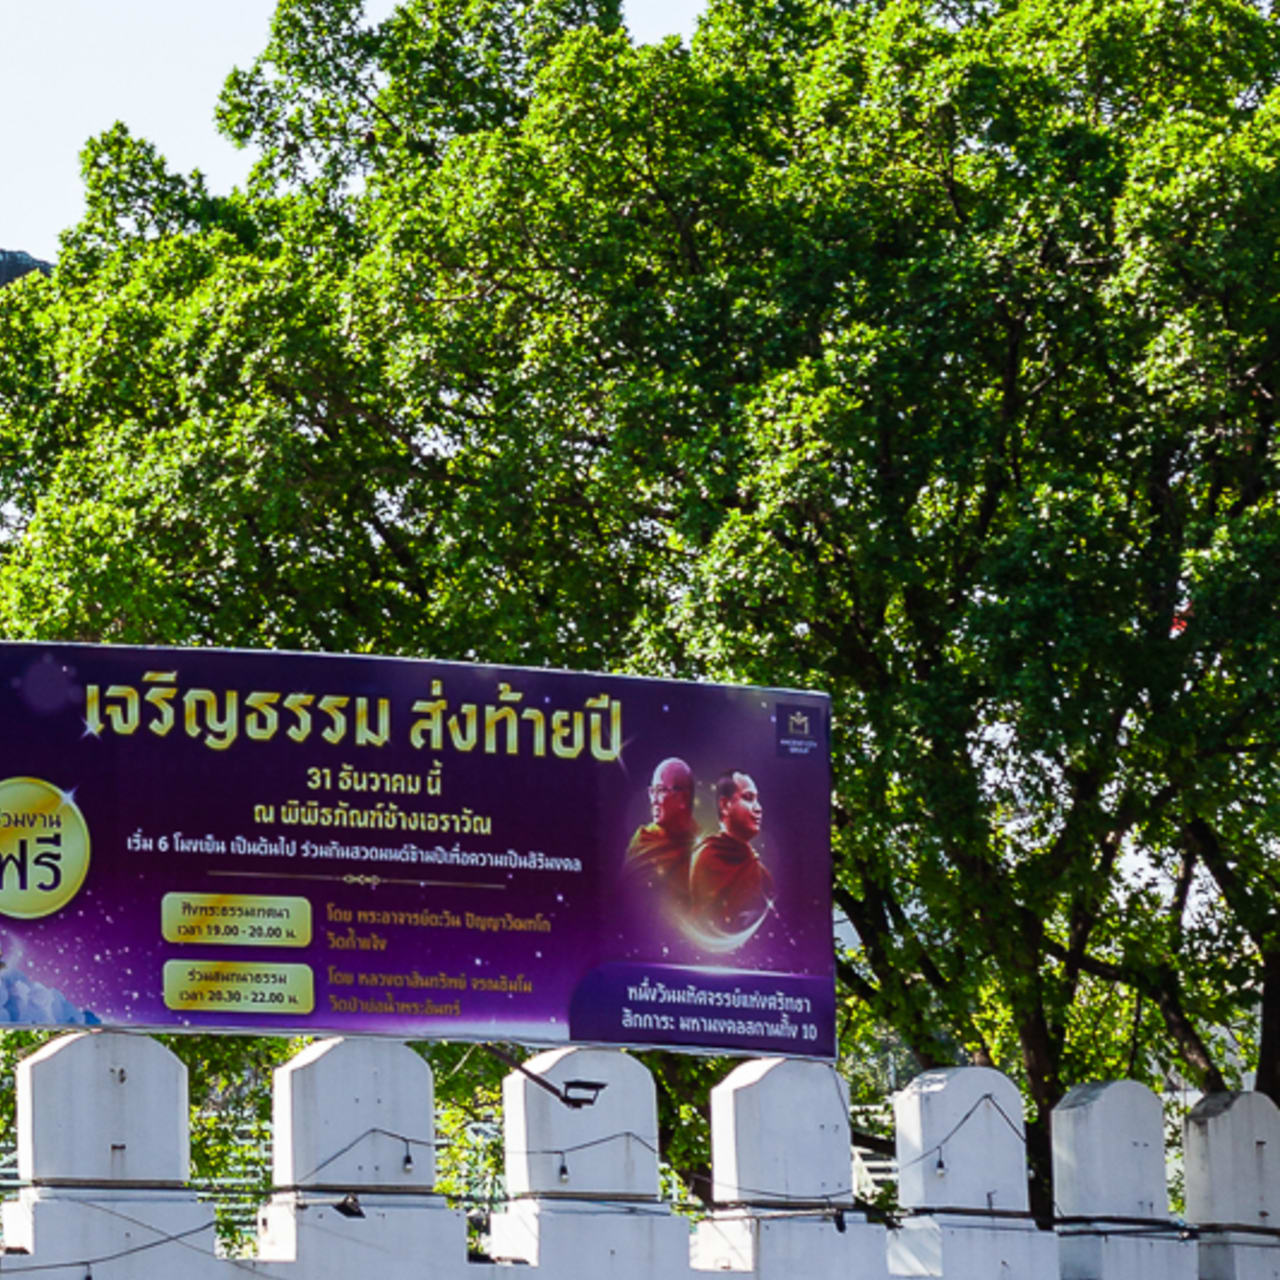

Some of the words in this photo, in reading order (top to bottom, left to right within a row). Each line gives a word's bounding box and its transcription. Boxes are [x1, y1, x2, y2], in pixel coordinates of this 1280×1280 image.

[86, 670, 390, 750] เจริญธรรม
[410, 679, 621, 761] ส่งท้ายปี
[306, 766, 332, 790] 31
[338, 763, 420, 794] ธันวาคม
[427, 759, 443, 795] นี้
[254, 803, 275, 823] ณ
[280, 799, 492, 835] พิพิธภัณฑ์ช้างเอราวัณ
[157, 835, 169, 852] 6
[205, 924, 240, 937] 19.00
[247, 925, 282, 938] 20.00
[802, 1023, 819, 1041] 10
